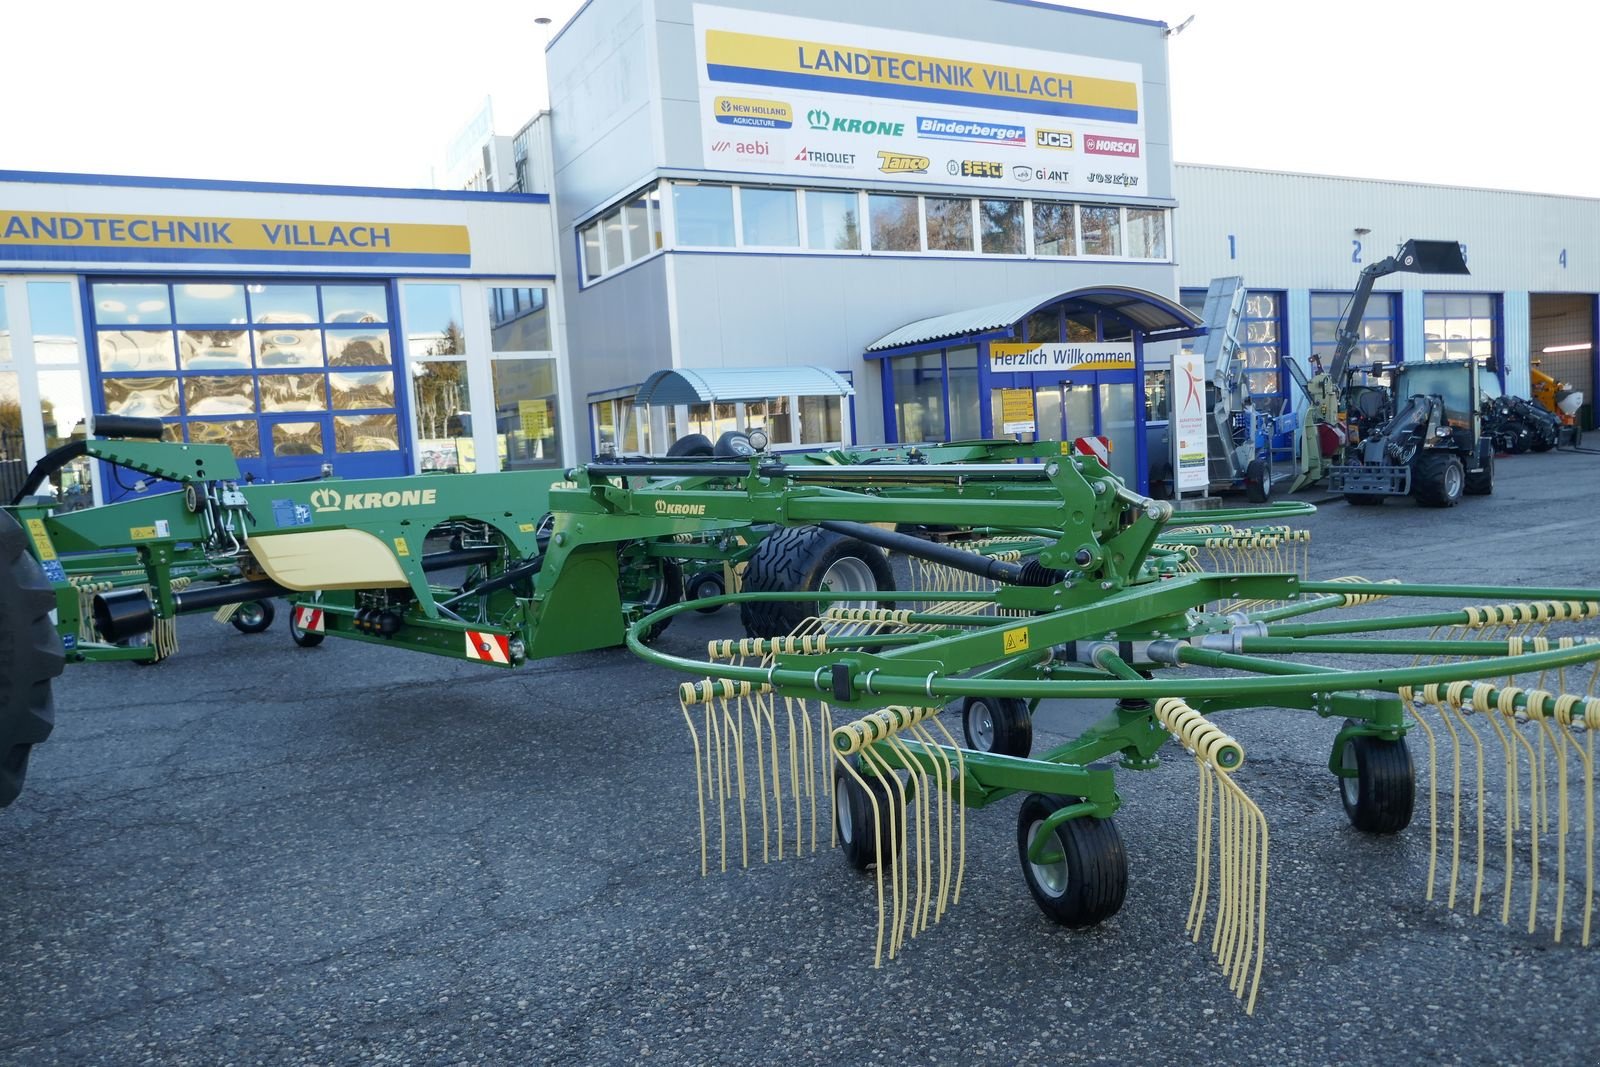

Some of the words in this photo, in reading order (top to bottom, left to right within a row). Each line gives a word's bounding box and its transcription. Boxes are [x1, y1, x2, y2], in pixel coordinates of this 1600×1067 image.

[798, 46, 975, 88] LANDTECHNIK
[983, 69, 1072, 99] VILLACH
[733, 104, 750, 113] NEW
[752, 105, 786, 116] HOLLAND
[733, 116, 775, 127] AGRICULTURE
[832, 117, 905, 137] KRONE
[920, 119, 1023, 140] Binderberger
[736, 140, 769, 155] aebi
[1038, 131, 1072, 148] JCB
[1095, 140, 1136, 153] HORSCH
[807, 150, 856, 165] TRIOLIET
[877, 151, 930, 172] Tanco
[0, 215, 233, 244] ANDTECHNIK
[261, 223, 390, 247] VILLACH
[1227, 234, 1236, 259] 1
[1351, 239, 1362, 263] 2
[1558, 248, 1567, 269] 4
[994, 349, 1047, 366] Herzlich
[1053, 349, 1132, 364] Willkommen
[344, 489, 437, 511] KRONE
[666, 503, 706, 515] KRONE
